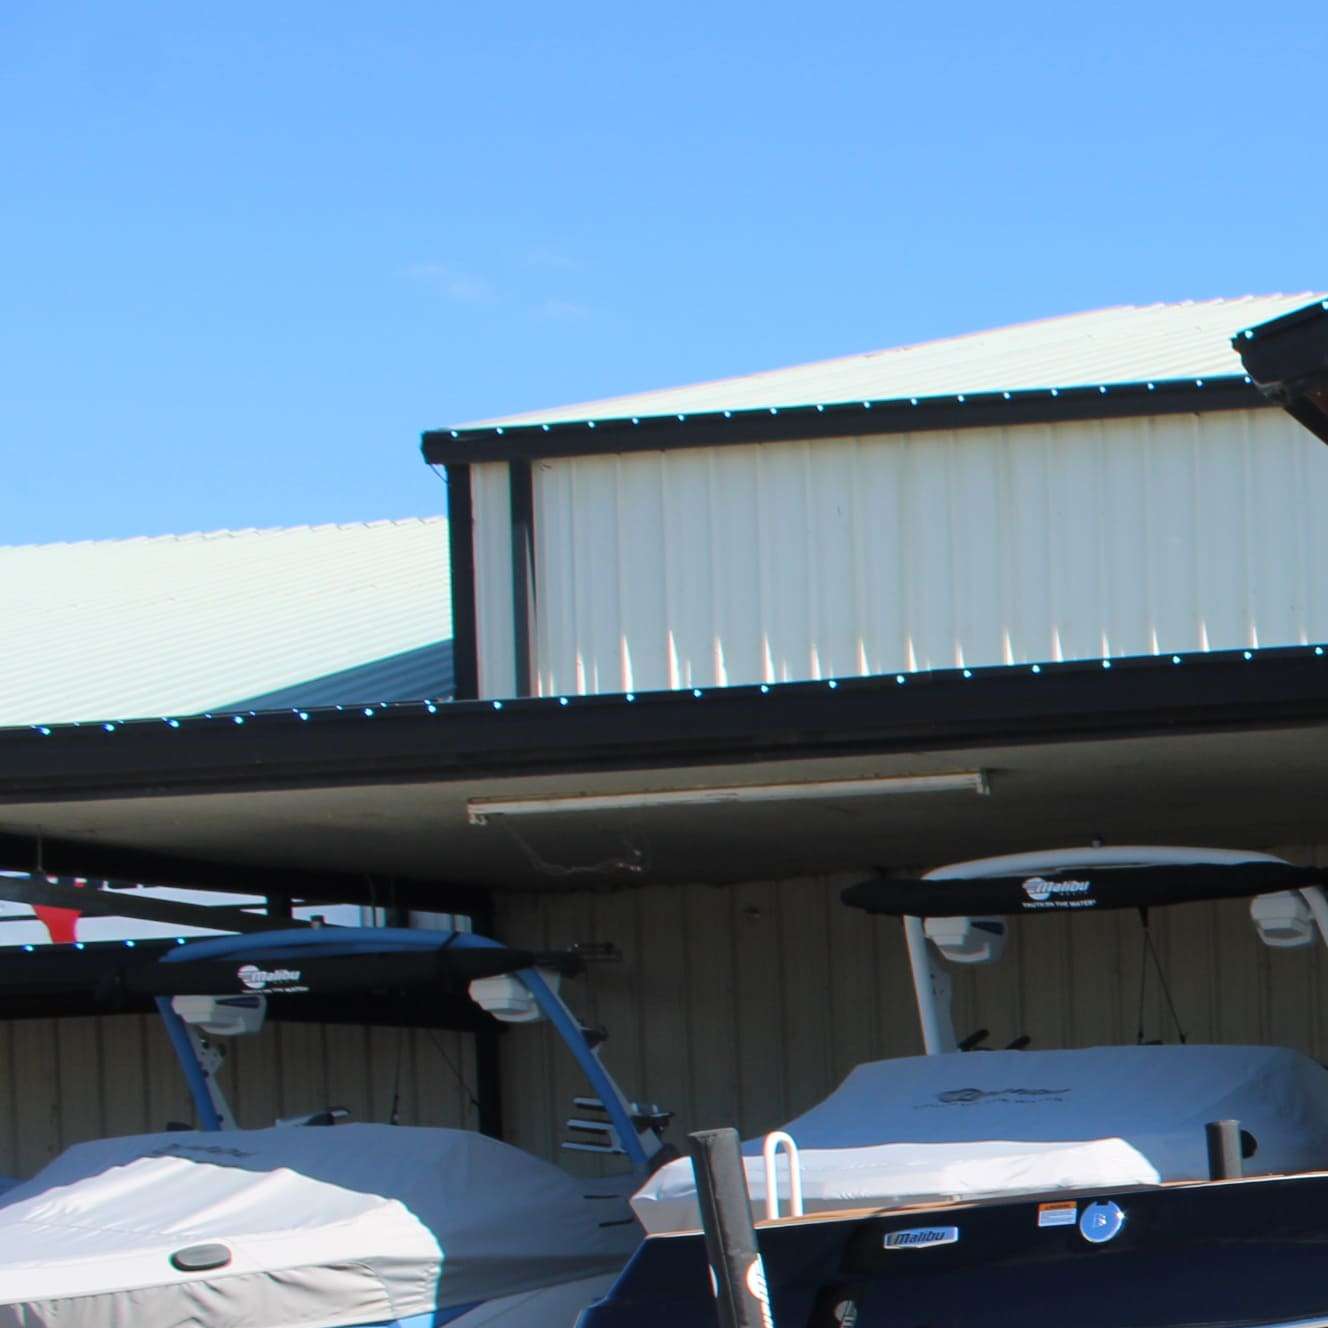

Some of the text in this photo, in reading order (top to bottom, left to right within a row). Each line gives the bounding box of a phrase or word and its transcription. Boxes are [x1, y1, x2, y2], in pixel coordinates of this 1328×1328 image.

[1036, 880, 1090, 892] Malibu
[251, 969, 301, 981] Malibu
[894, 1230, 946, 1246] Malibu
